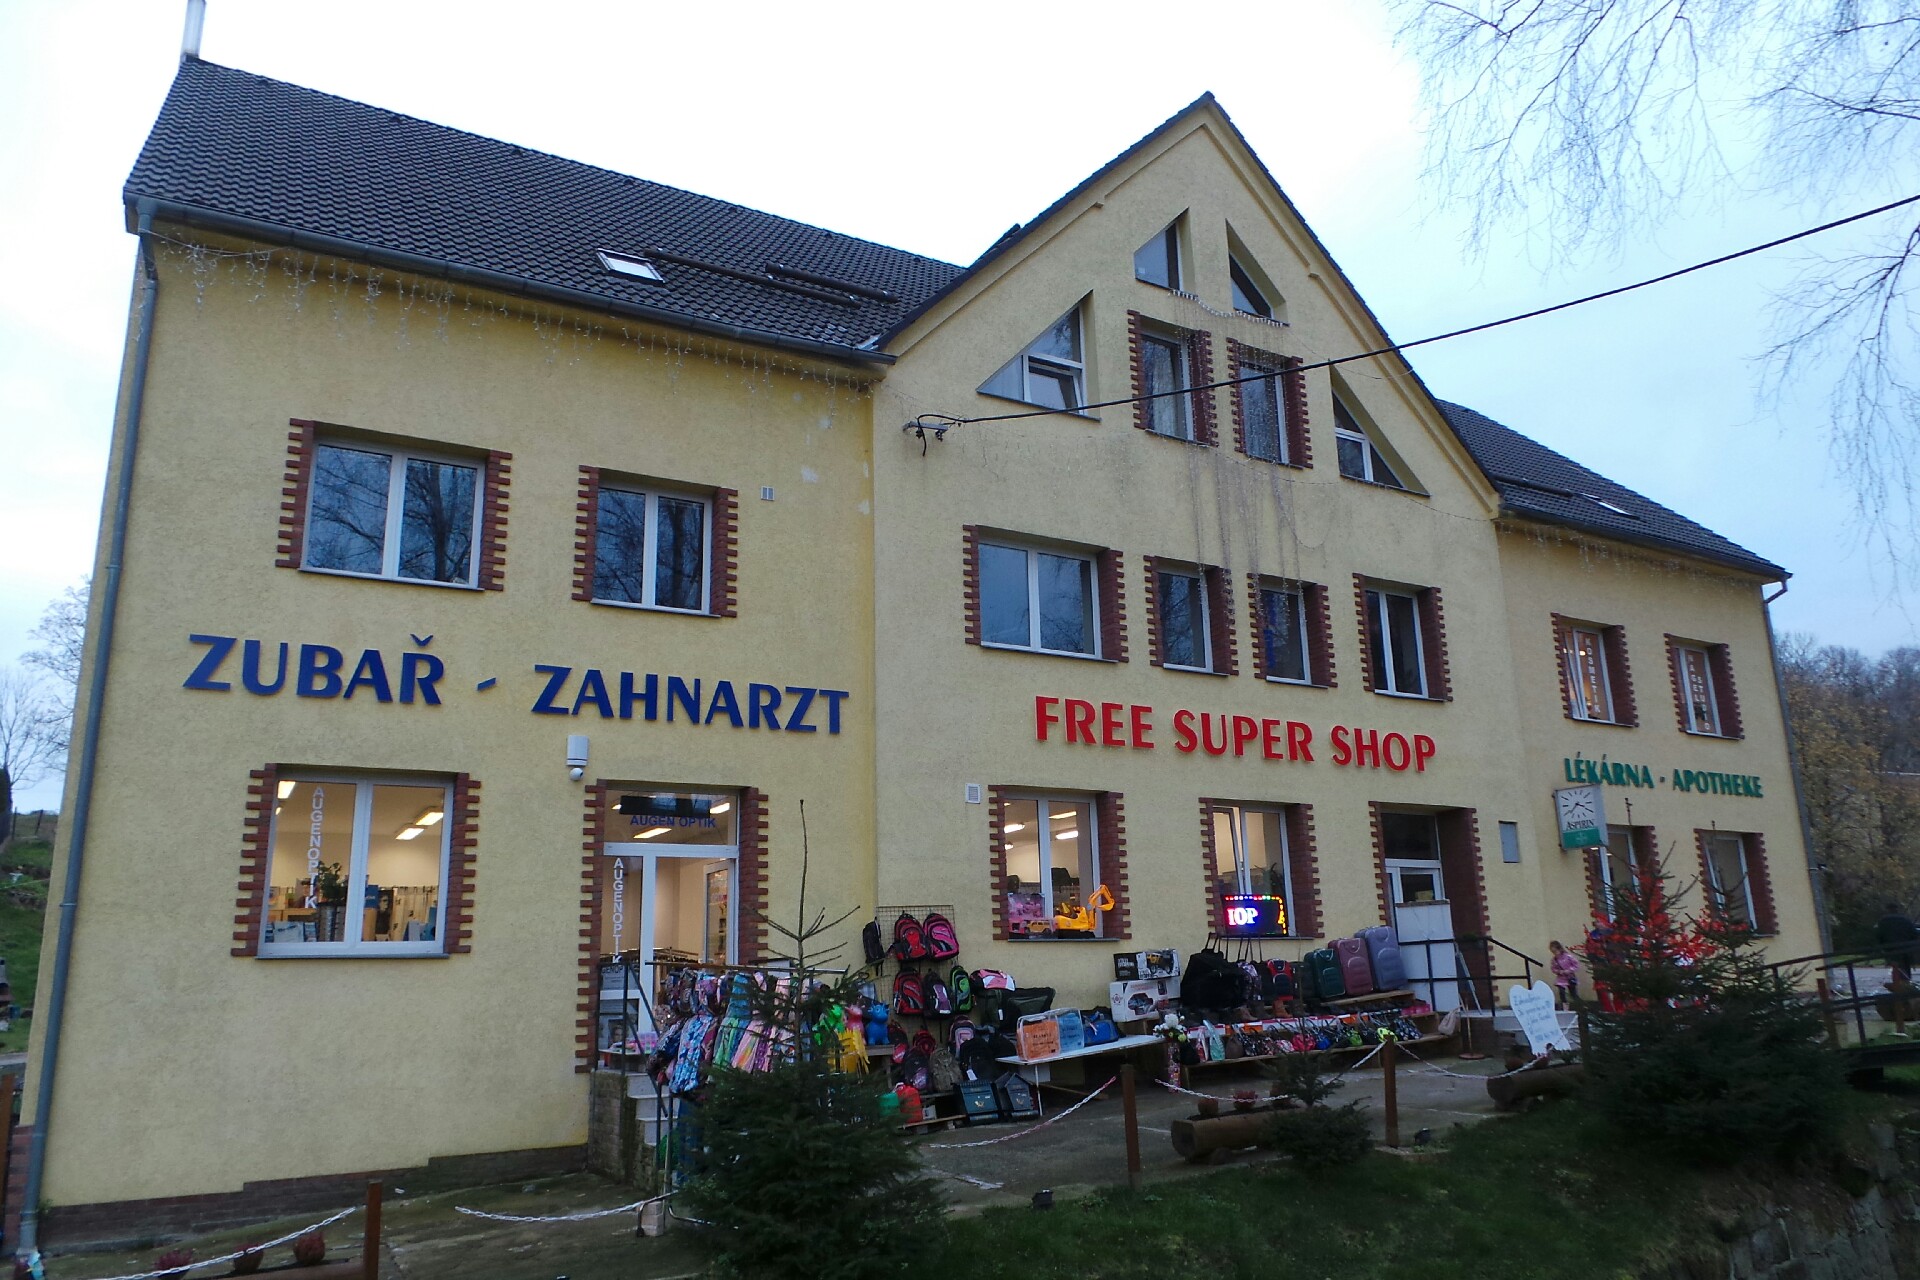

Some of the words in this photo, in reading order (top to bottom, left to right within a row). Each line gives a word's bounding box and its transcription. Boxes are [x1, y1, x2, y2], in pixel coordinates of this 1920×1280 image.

[182, 633, 444, 705] ZUBAŘ
[531, 664, 849, 734] ZAHNARZT
[1585, 638, 1601, 713] KOSMETIK
[1035, 695, 1155, 749] FREE
[1174, 709, 1316, 762] SUPER
[1330, 725, 1437, 772] SHOP
[1563, 751, 1655, 789] LÉKÁRNA
[1672, 768, 1764, 798] APOTHEKE
[305, 786, 324, 909] AUGENOPTIK
[630, 815, 675, 827] AUGEN
[678, 817, 716, 828] OPTIK
[612, 857, 624, 964] AUGENOPTIK
